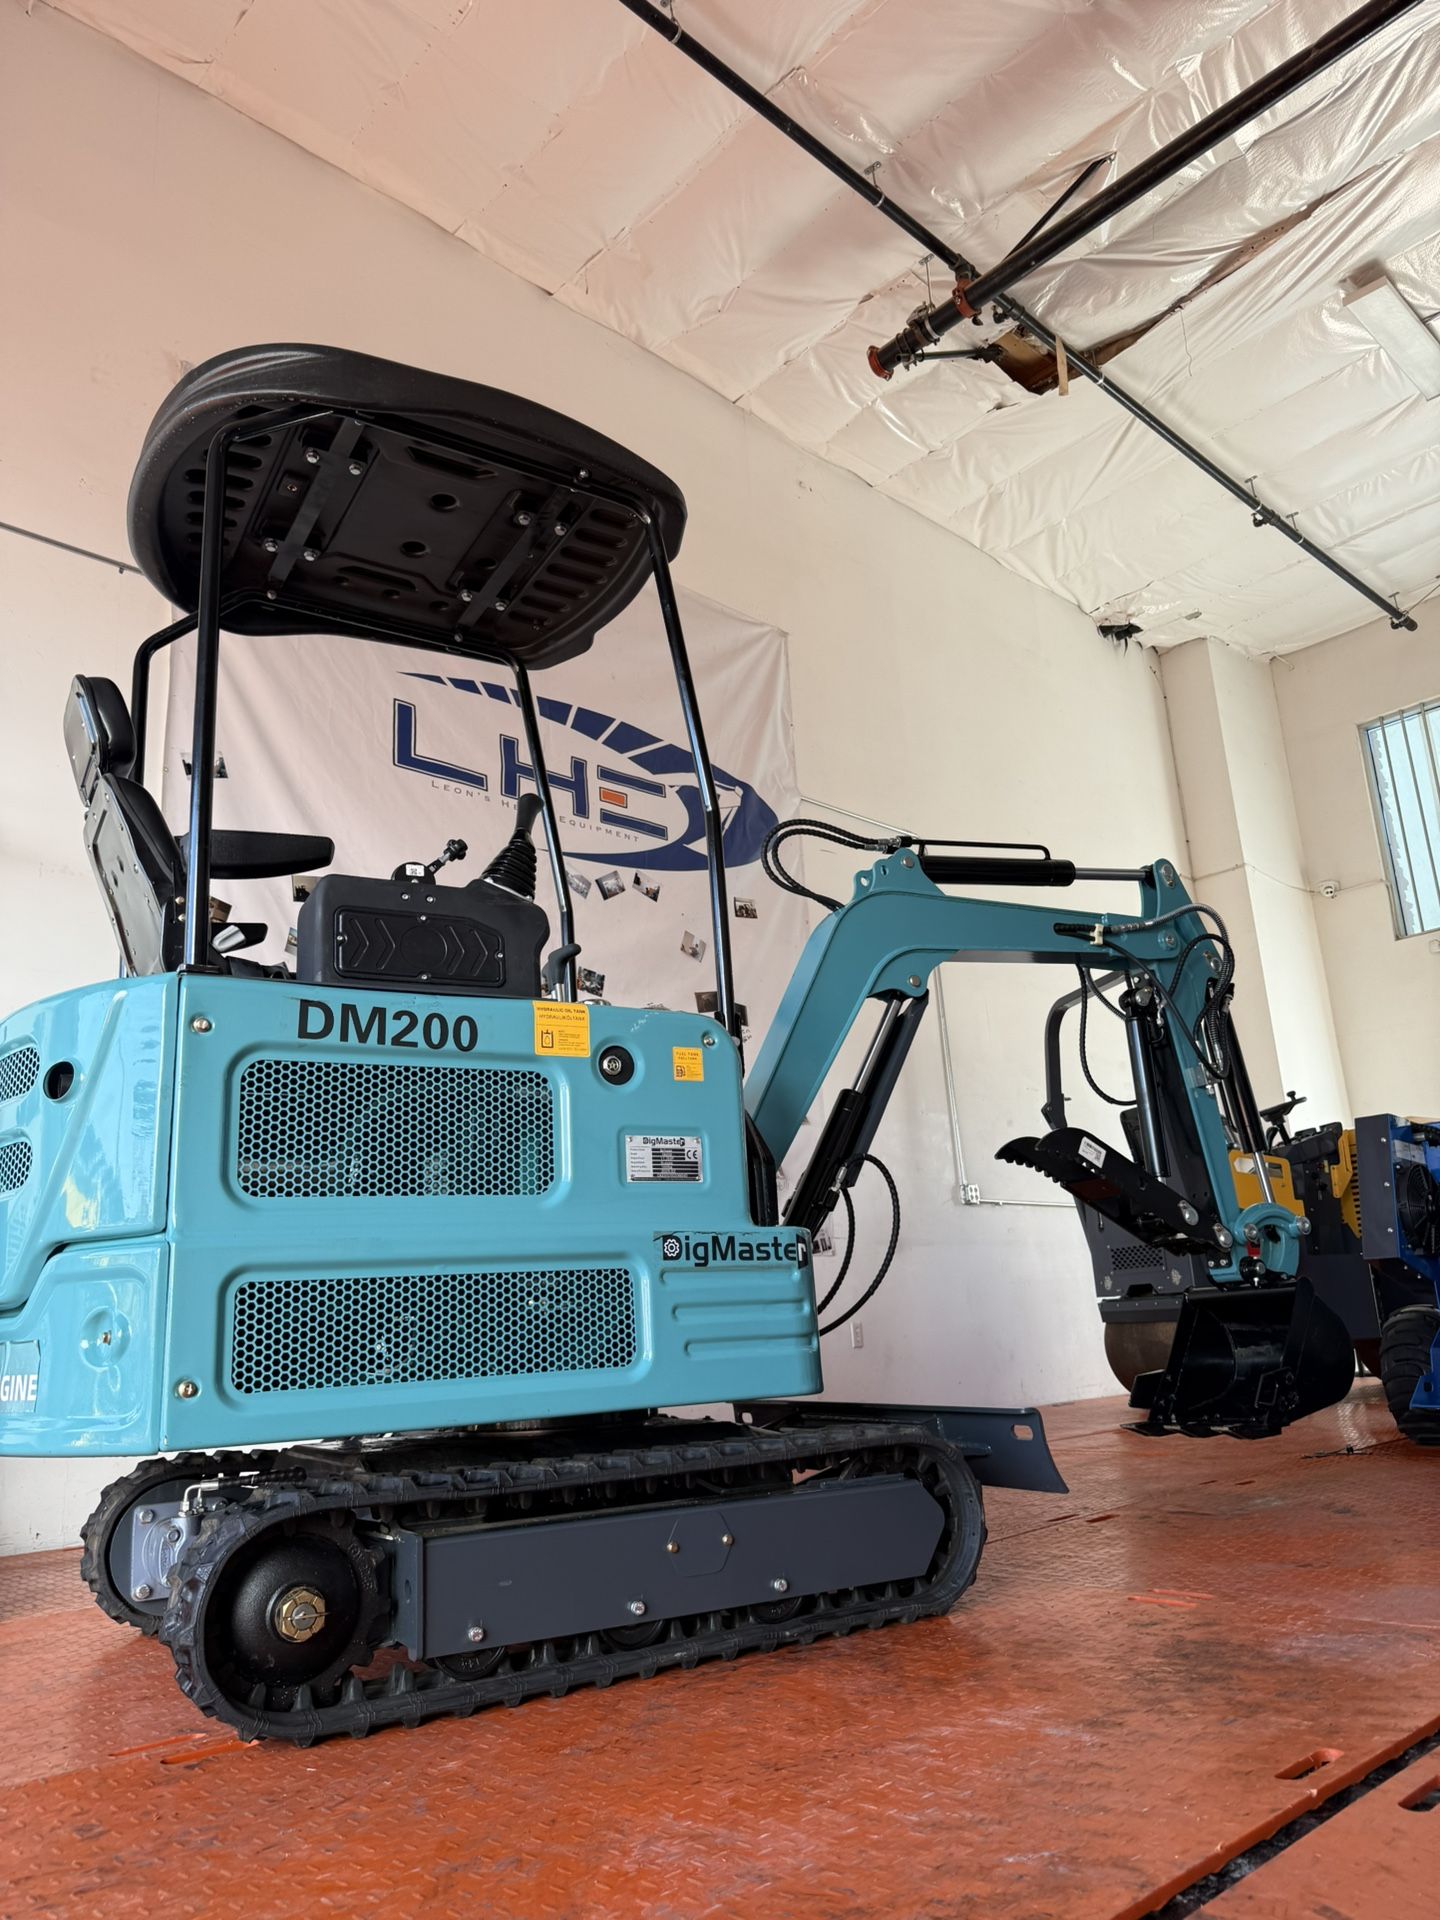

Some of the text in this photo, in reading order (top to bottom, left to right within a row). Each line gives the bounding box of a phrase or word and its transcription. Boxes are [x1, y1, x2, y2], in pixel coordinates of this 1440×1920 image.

[431, 780, 640, 842] LEON'S EQUIPMENT
[298, 998, 479, 1052] DM200
[642, 1136, 686, 1147] DigMaster
[686, 1149, 698, 1160] CE
[662, 1234, 809, 1269] DigMaster
